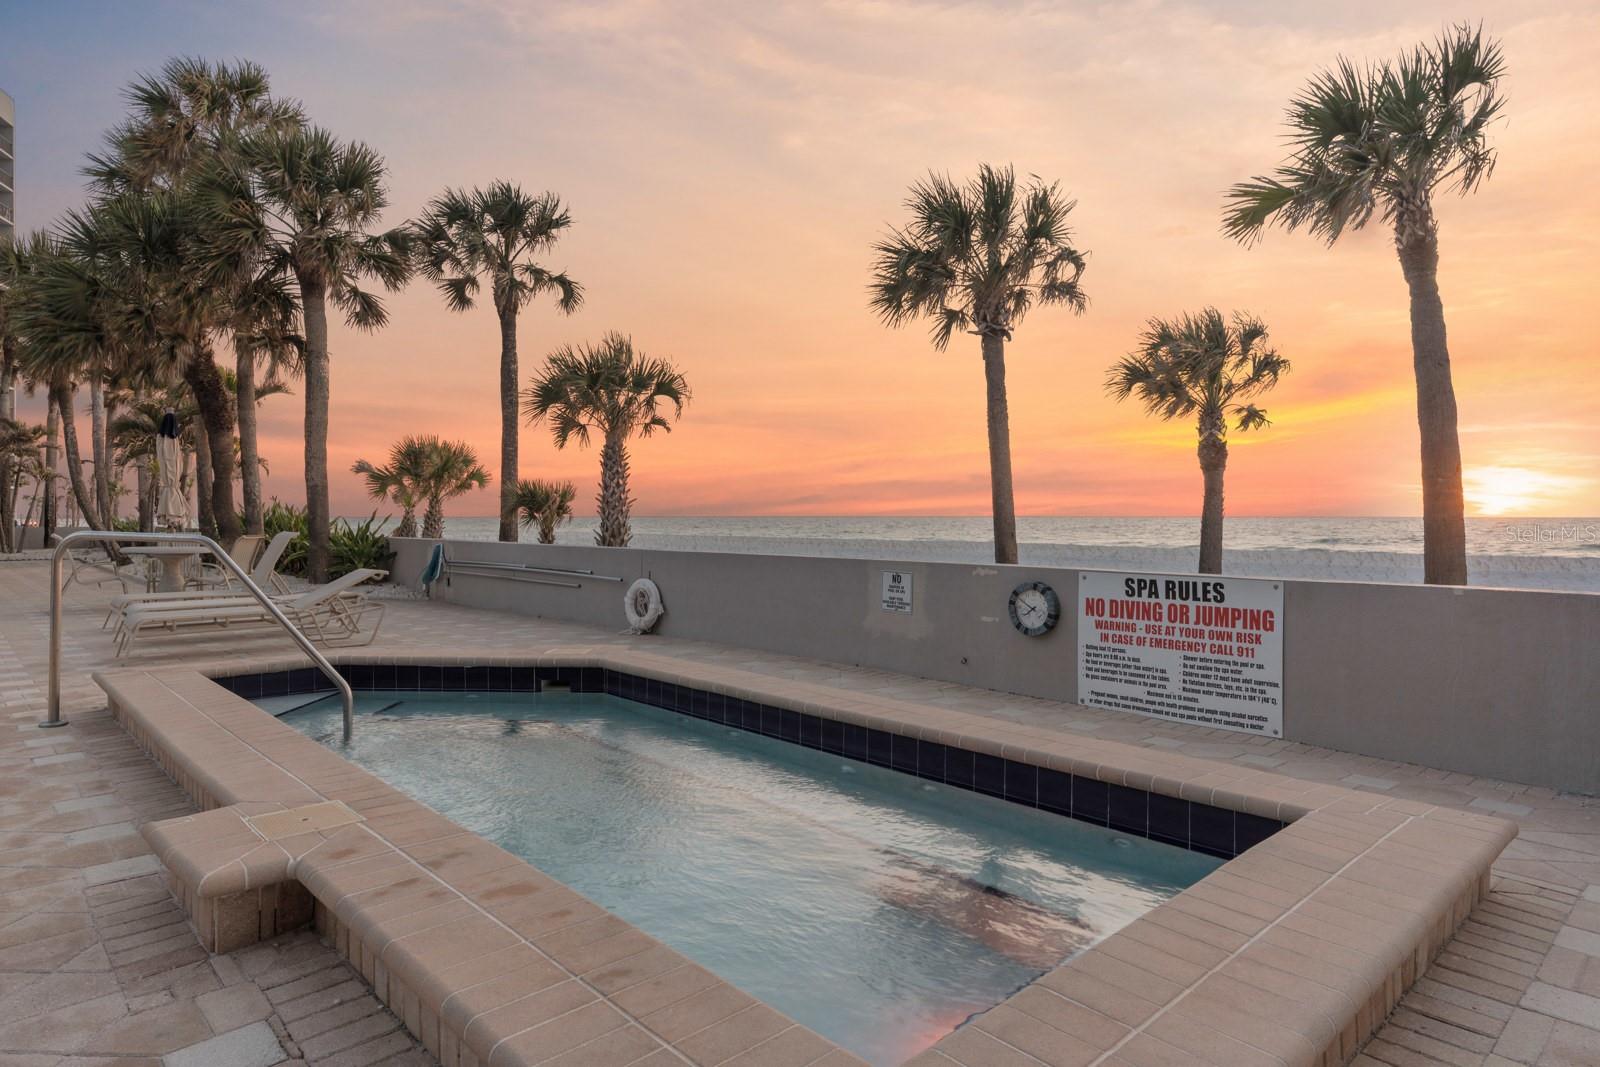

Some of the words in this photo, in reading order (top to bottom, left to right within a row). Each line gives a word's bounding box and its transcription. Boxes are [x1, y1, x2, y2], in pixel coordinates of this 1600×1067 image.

[892, 574, 901, 584] NO
[1125, 578, 1159, 599] SPA
[1165, 580, 1225, 603] RULES
[1086, 598, 1105, 617] NO
[1109, 599, 1163, 622] DIVING
[1167, 604, 1190, 624] OR
[1194, 605, 1274, 632] JUMPING
[1095, 620, 1137, 634] WARNING
[1145, 624, 1162, 635] USE
[1164, 626, 1176, 636] AT
[1179, 627, 1205, 639] YOUR
[1209, 630, 1232, 642] OWN
[1236, 632, 1262, 644] RISK
[1101, 633, 1110, 643] IN
[1112, 634, 1133, 645] CASE
[1136, 636, 1148, 647] OF
[1149, 638, 1206, 654] EMERGENCY
[1209, 644, 1233, 656] CALL
[1237, 647, 1255, 658] 911
[1215, 690, 1242, 700] temperature
